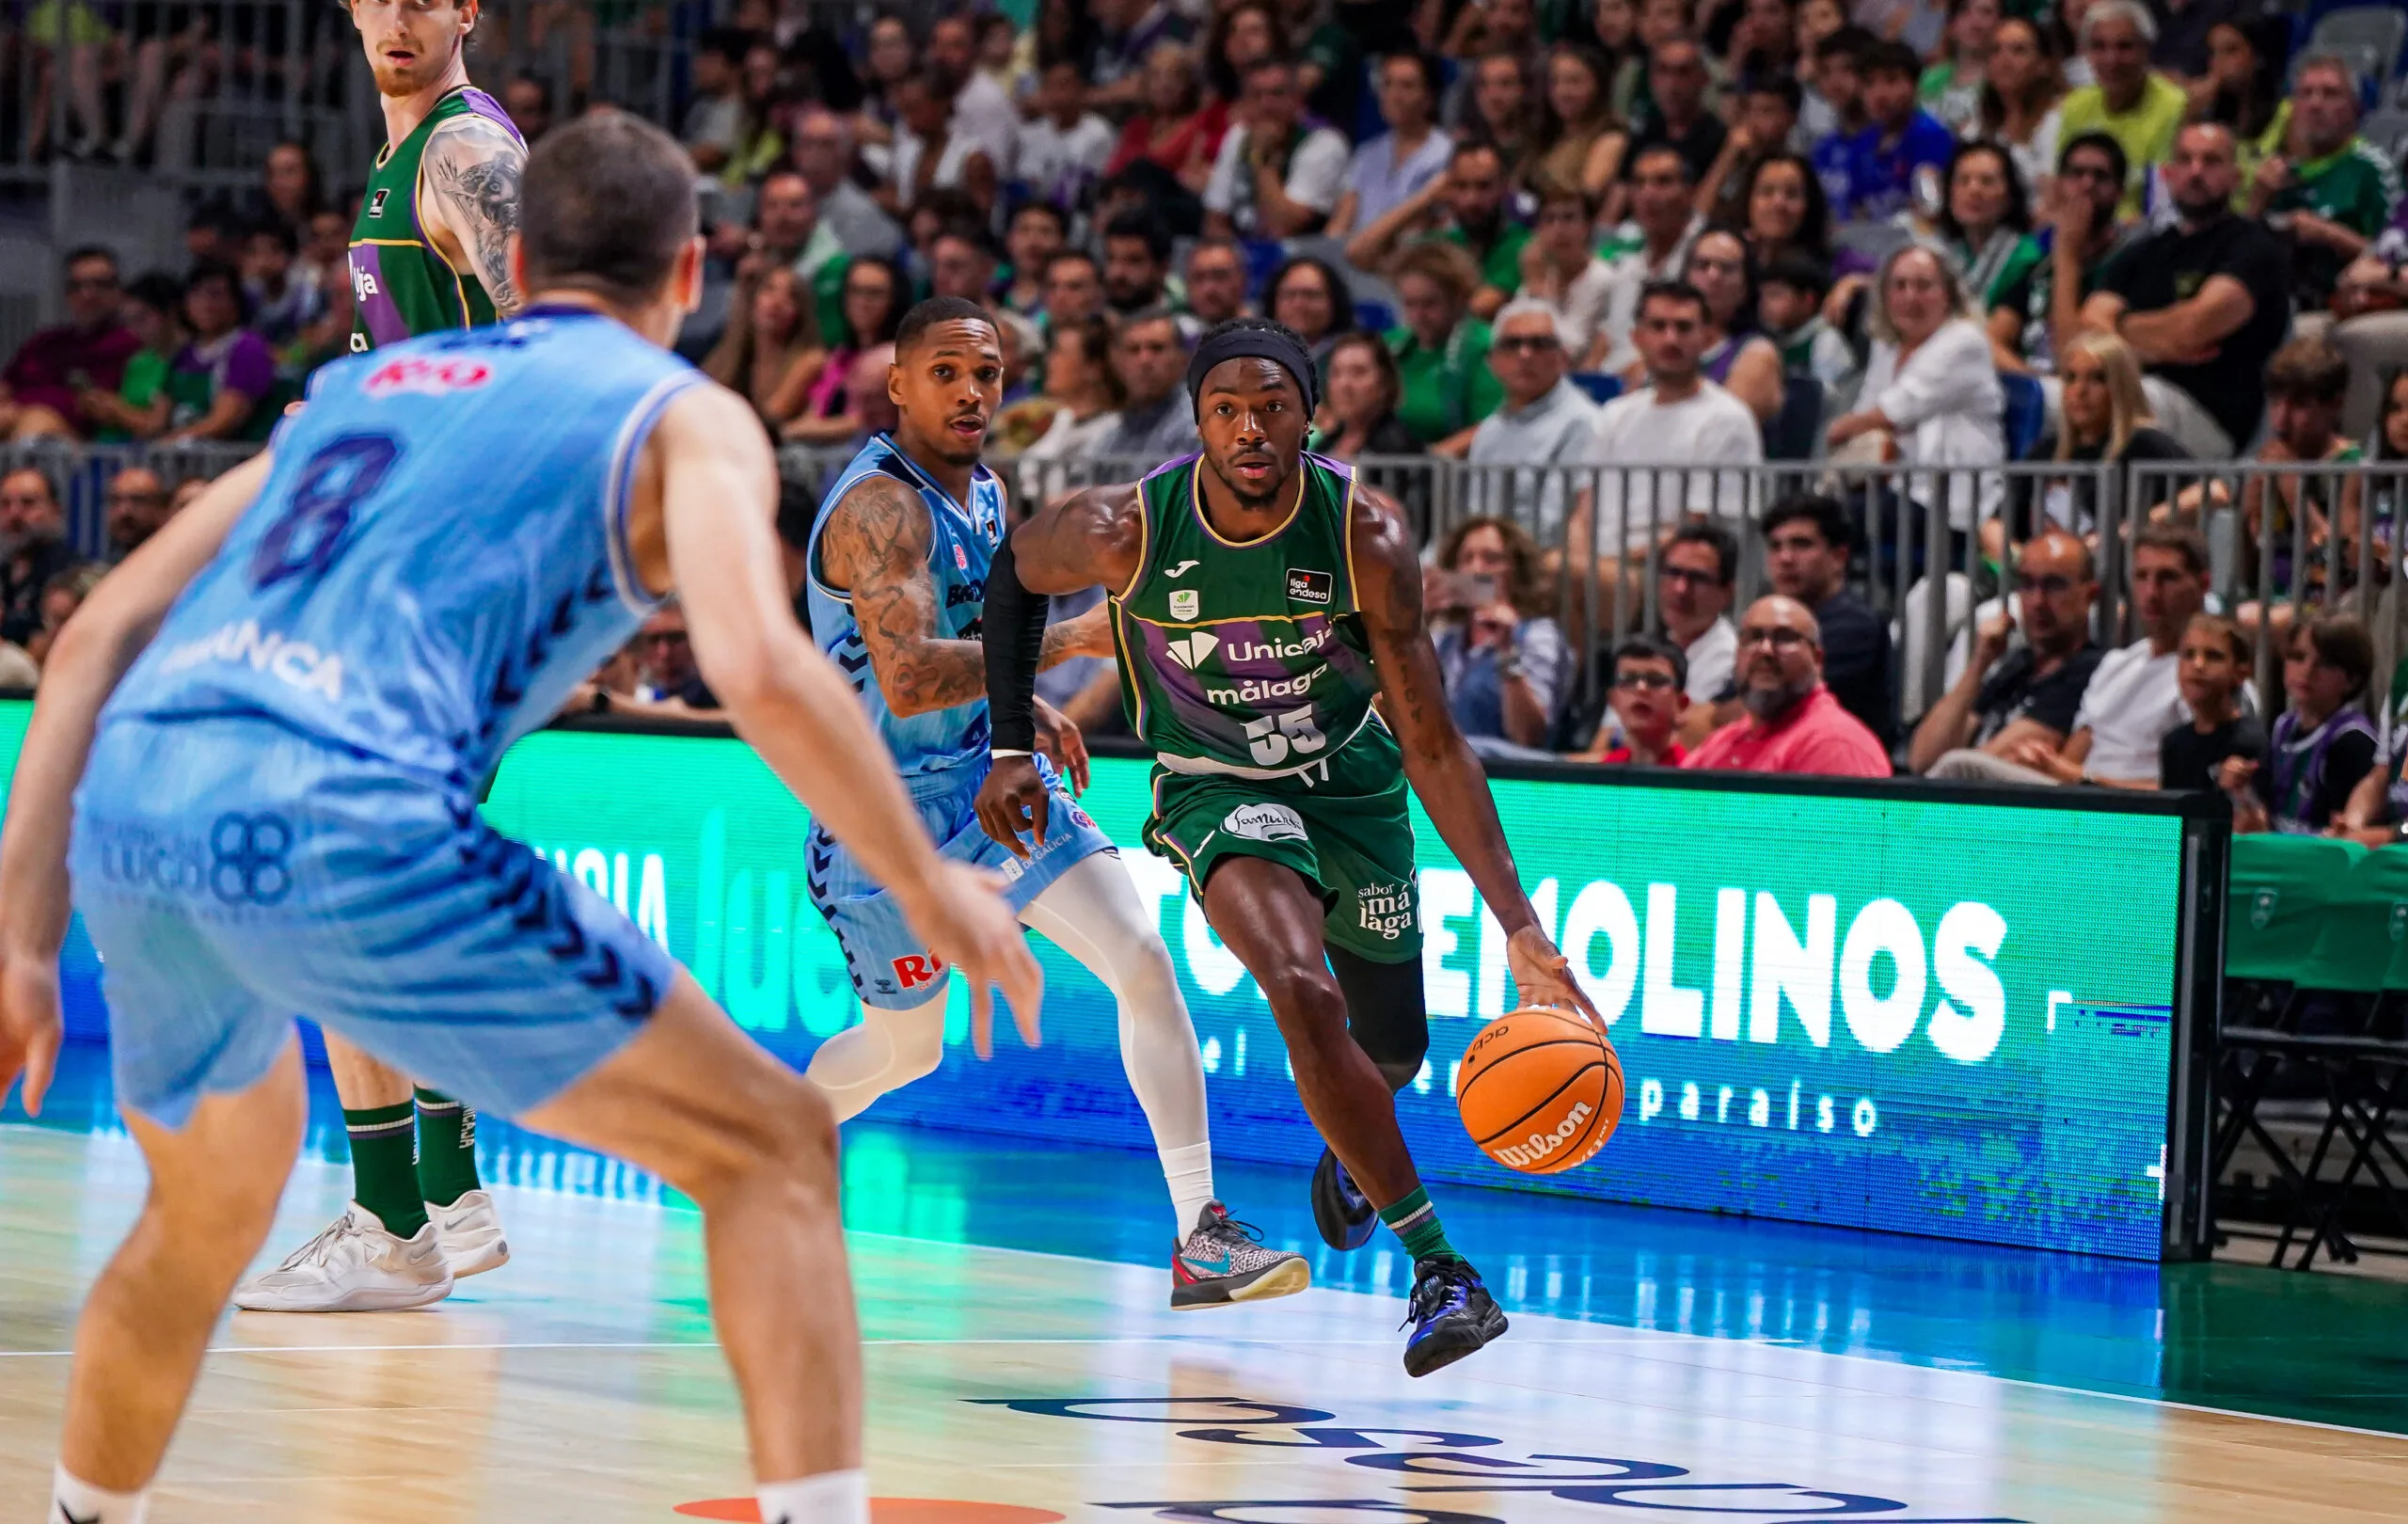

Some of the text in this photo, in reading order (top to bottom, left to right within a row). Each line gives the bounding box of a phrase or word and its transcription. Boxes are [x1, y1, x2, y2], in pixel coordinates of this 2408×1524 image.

[250, 434, 402, 593] 8
[1289, 577, 1308, 590] liga
[1289, 588, 1327, 600] endesa
[1239, 703, 1326, 766] 55
[1357, 882, 1395, 897] sabor
[1493, 1100, 1592, 1167] Wilson
